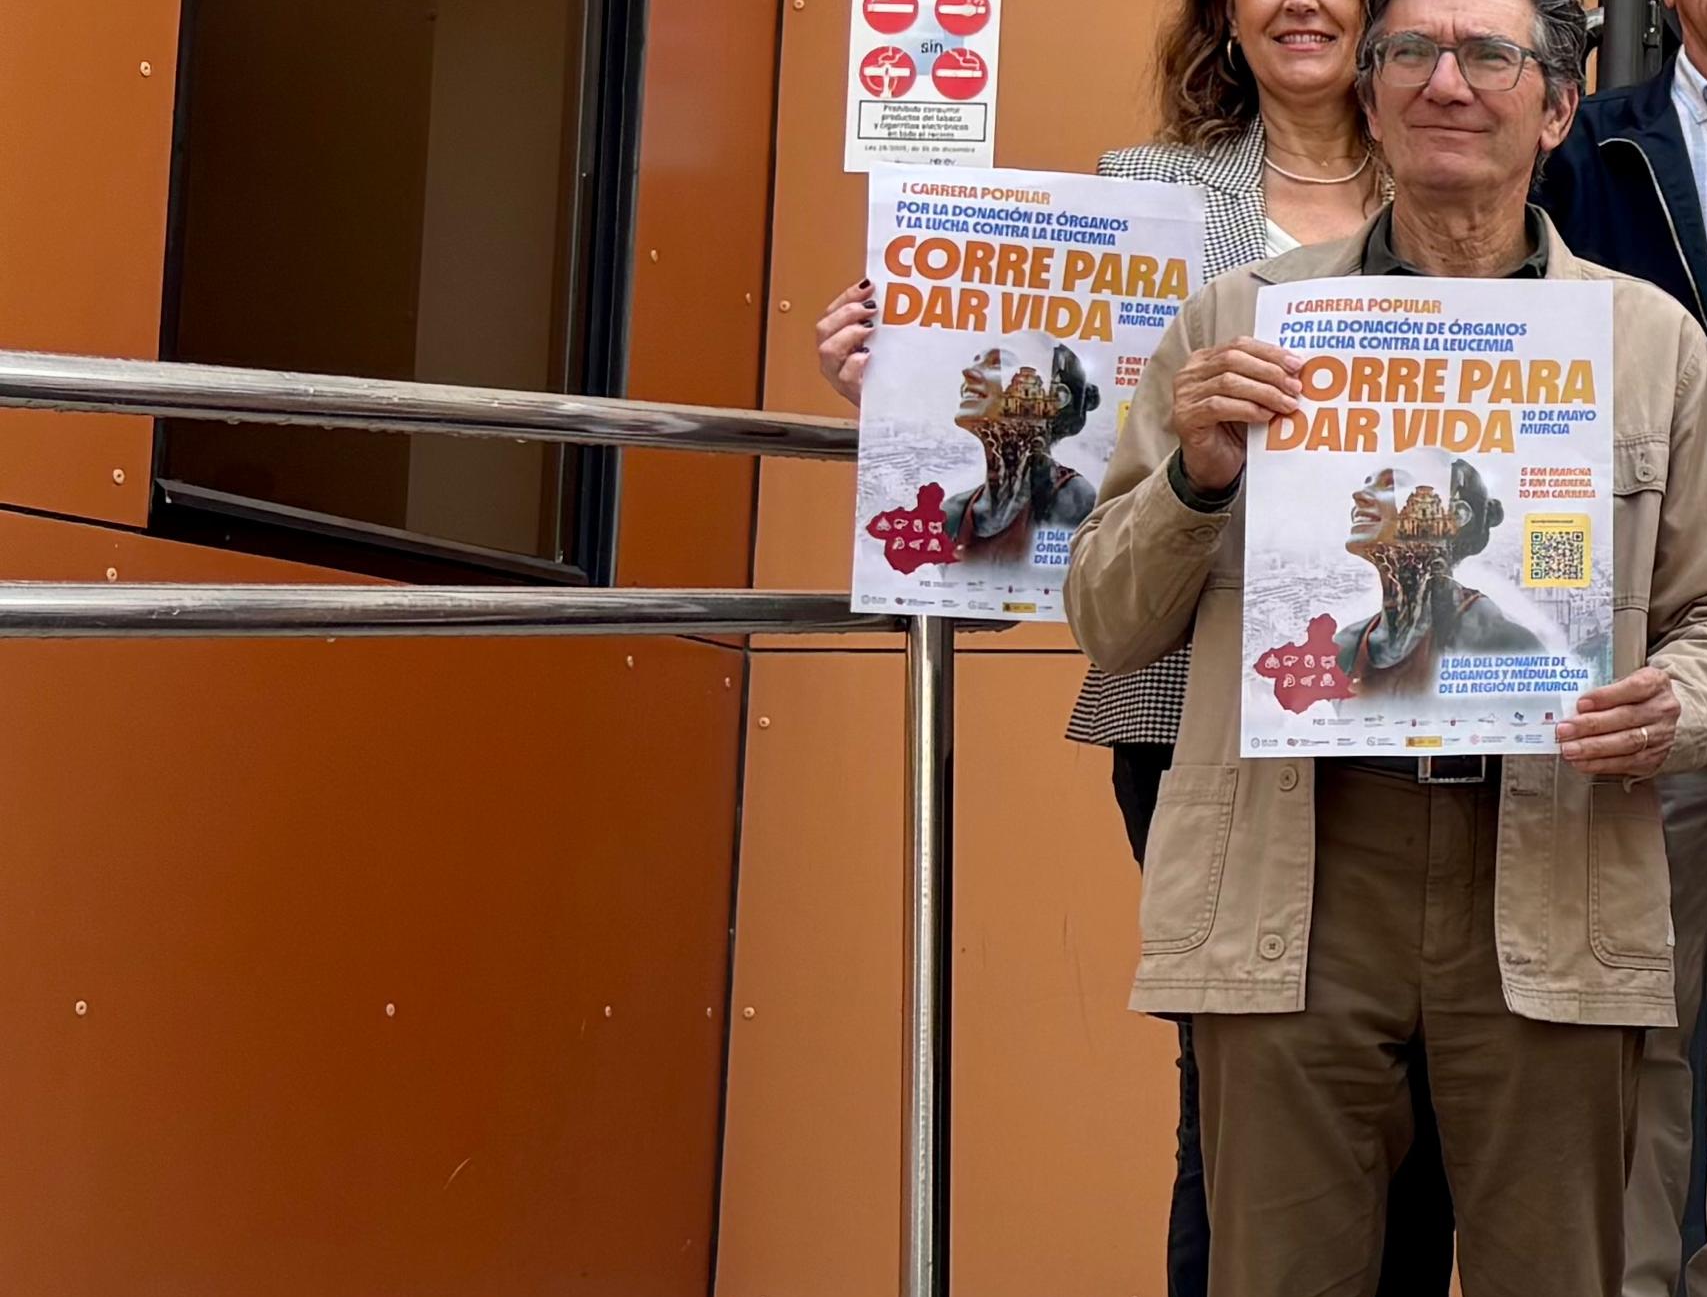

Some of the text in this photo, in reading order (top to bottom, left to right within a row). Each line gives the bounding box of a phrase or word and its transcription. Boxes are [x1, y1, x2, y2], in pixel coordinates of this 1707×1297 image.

[920, 39, 943, 53] sin
[911, 183, 977, 199] CARRERA
[980, 187, 1051, 204] POPULAR
[897, 201, 1129, 231] POR LA DONACIÓN DE ÓRGANOS
[896, 215, 1116, 246] Y LA LUCHA CONTRA LA LEUCEMIA
[884, 235, 1190, 301] CORRE PARA
[882, 282, 1114, 343] DAR VIDA
[1120, 301, 1179, 316] 10 DE MAY
[1295, 299, 1364, 313] CARRERA
[1368, 299, 1442, 314] POPULAR
[1118, 314, 1165, 327] MURCIA
[1280, 317, 1527, 335] POR LA DONACIÓN DE ÓRGANOS
[1279, 336, 1514, 353] Y LA LUCHA CONTRA LA LEUCEMIA
[1298, 355, 1596, 405] ORRE PARA
[1521, 410, 1597, 422] 10 DE MAYO
[1264, 407, 1515, 453] DAR VIDA
[1520, 423, 1570, 435] MURCIA
[1451, 655, 1472, 669] DÍA
[1473, 657, 1494, 669] DEL
[1495, 657, 1551, 668] DONANTE
[1552, 657, 1566, 667] DE
[1440, 667, 1500, 681] ÓRGANOS
[1510, 667, 1558, 680] MÉDULA
[1440, 679, 1578, 694] DE LA REGIÓN DE MURCIA
